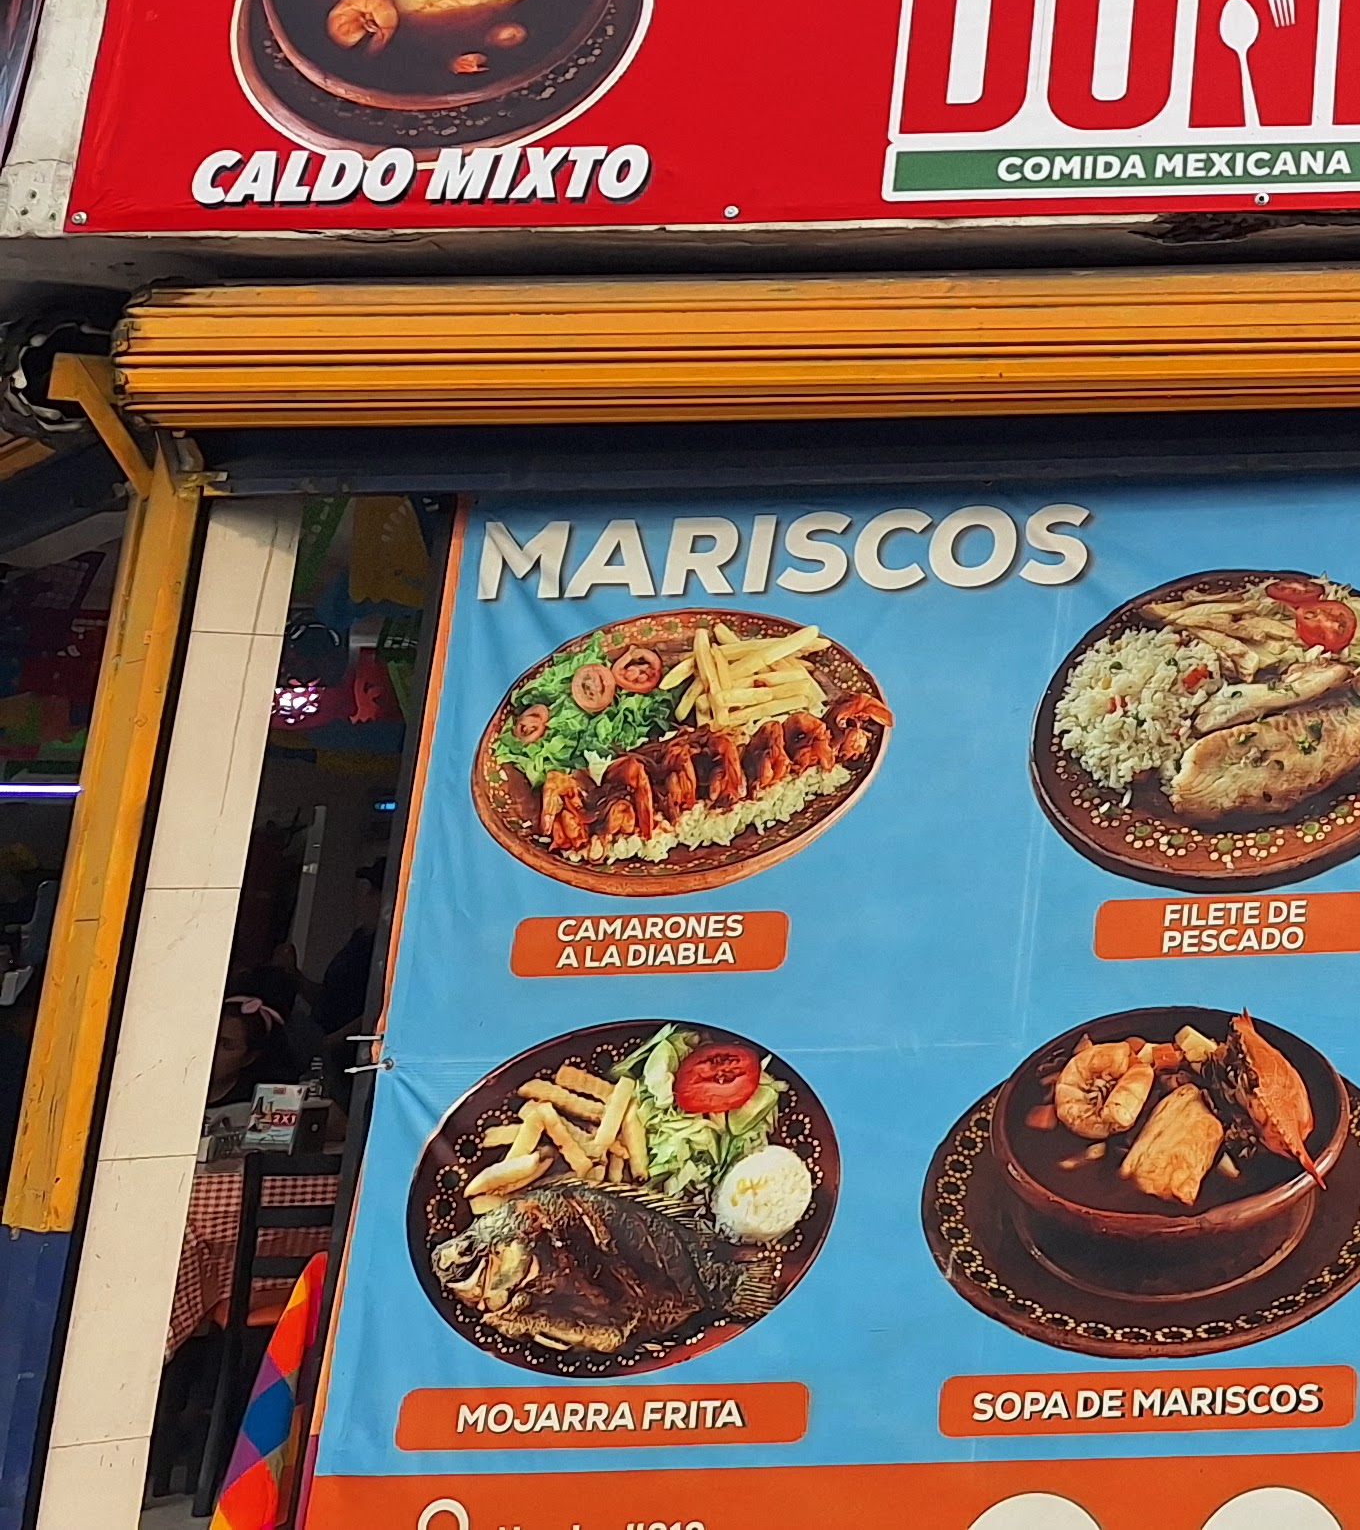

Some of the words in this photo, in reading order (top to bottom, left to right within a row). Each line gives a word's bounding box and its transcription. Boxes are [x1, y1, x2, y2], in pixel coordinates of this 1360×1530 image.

[191, 149, 414, 206] CALDO
[425, 144, 649, 203] MIXTO
[997, 153, 1146, 183] COMIDA
[1154, 149, 1352, 179] MEXICANA
[477, 504, 1094, 600] MARISCOS
[557, 915, 744, 942] CAMARONES
[1163, 901, 1261, 927] FILETE
[1267, 900, 1308, 924] DE
[556, 946, 579, 968] A
[585, 944, 622, 968] LA
[626, 941, 735, 967] DIABLA
[1161, 926, 1305, 954] PESCADO
[456, 1402, 635, 1434] MOJARRA
[641, 1399, 745, 1430] FRITA
[972, 1391, 1070, 1422] SOPA
[1076, 1389, 1123, 1420] DE
[1132, 1383, 1323, 1419] MARISCOS
